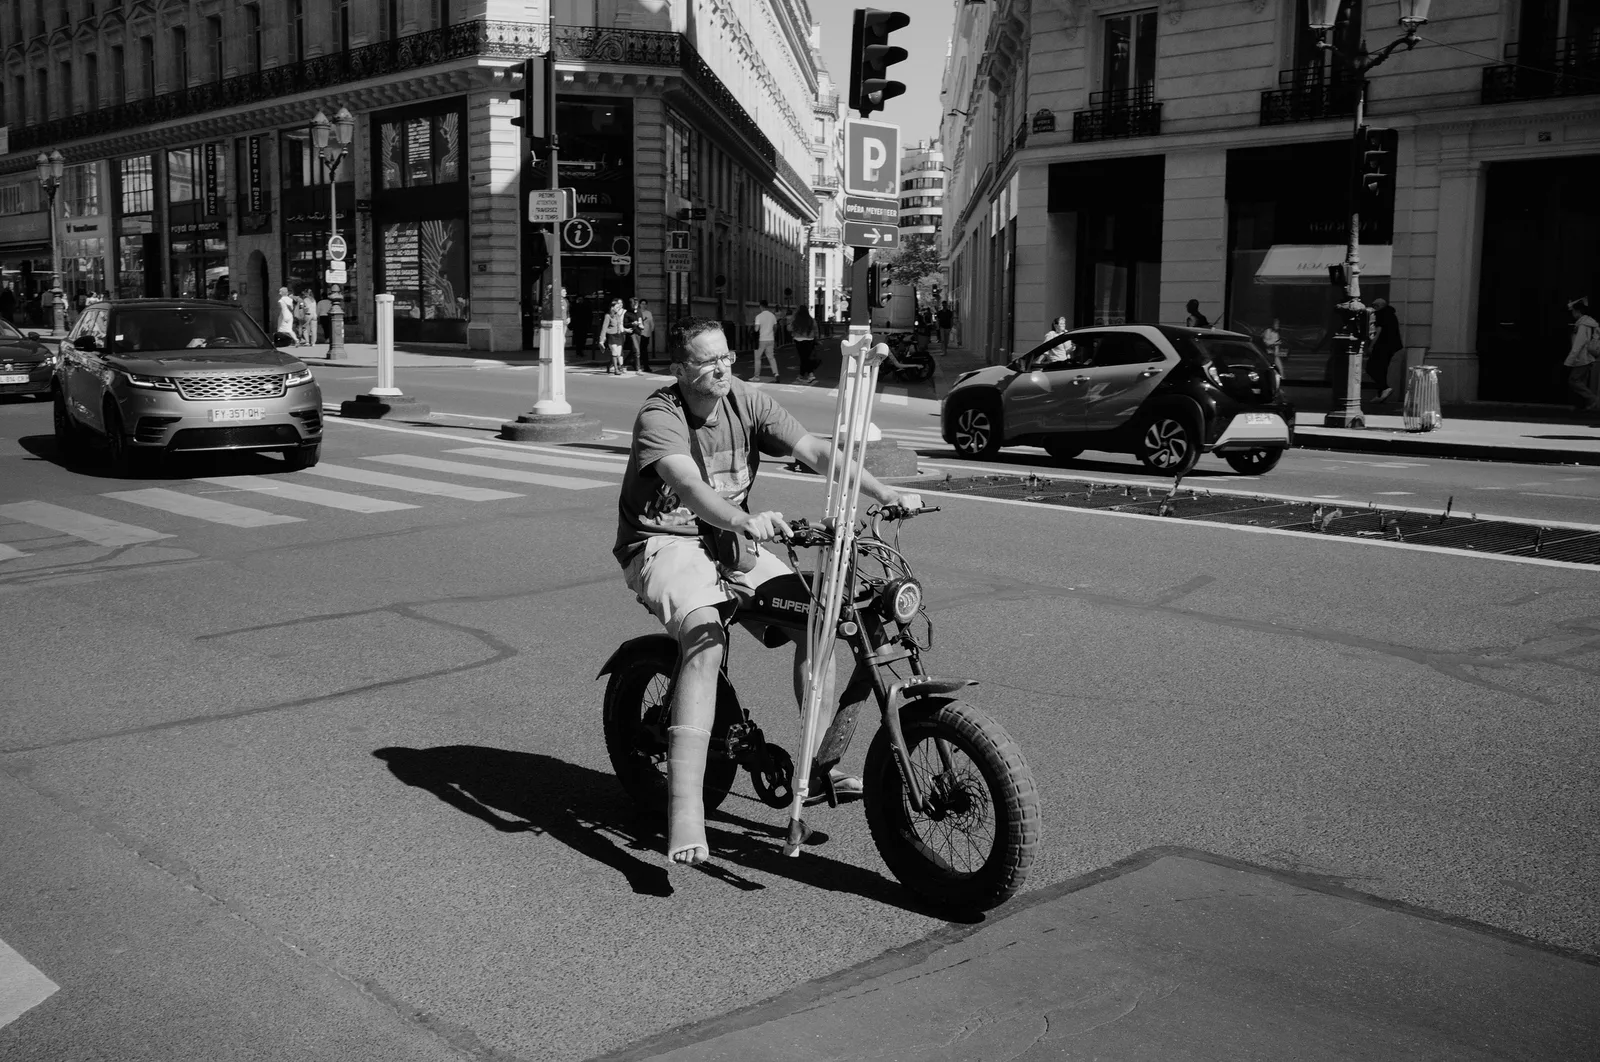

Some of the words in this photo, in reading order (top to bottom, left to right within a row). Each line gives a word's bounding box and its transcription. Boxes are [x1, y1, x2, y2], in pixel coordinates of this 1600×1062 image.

[207, 146, 215, 171] royal
[863, 136, 887, 181] P
[208, 192, 216, 214] maroc
[252, 187, 260, 210] maroc
[576, 194, 598, 204] Wifi
[846, 203, 865, 214] OPÉRA
[171, 223, 188, 234] royal
[188, 224, 198, 232] air
[198, 222, 219, 231] maroc
